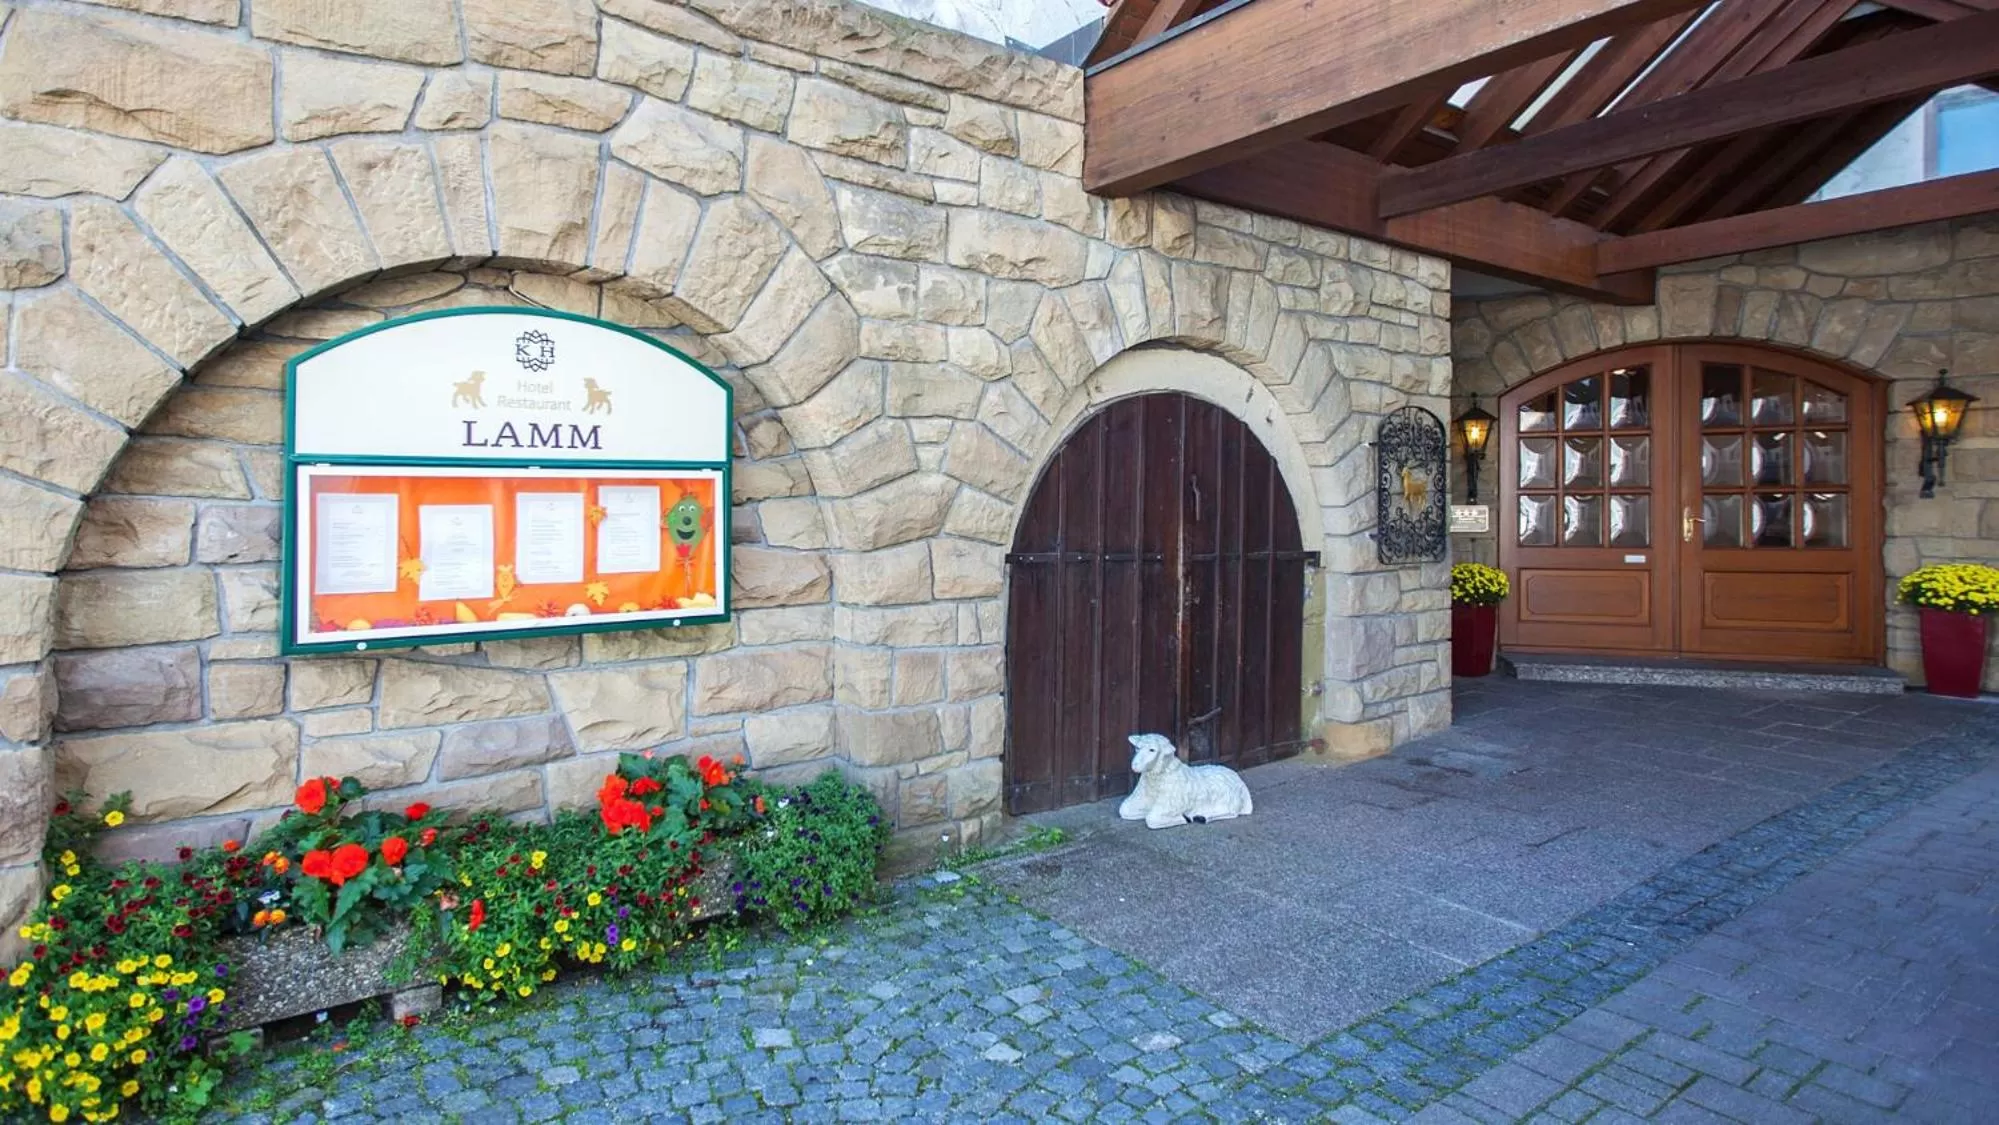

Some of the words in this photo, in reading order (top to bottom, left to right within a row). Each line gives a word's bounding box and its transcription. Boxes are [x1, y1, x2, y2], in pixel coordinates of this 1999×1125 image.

[517, 379, 554, 394] Hotel
[497, 395, 572, 412] Restaurant
[462, 420, 603, 450] LAMM
